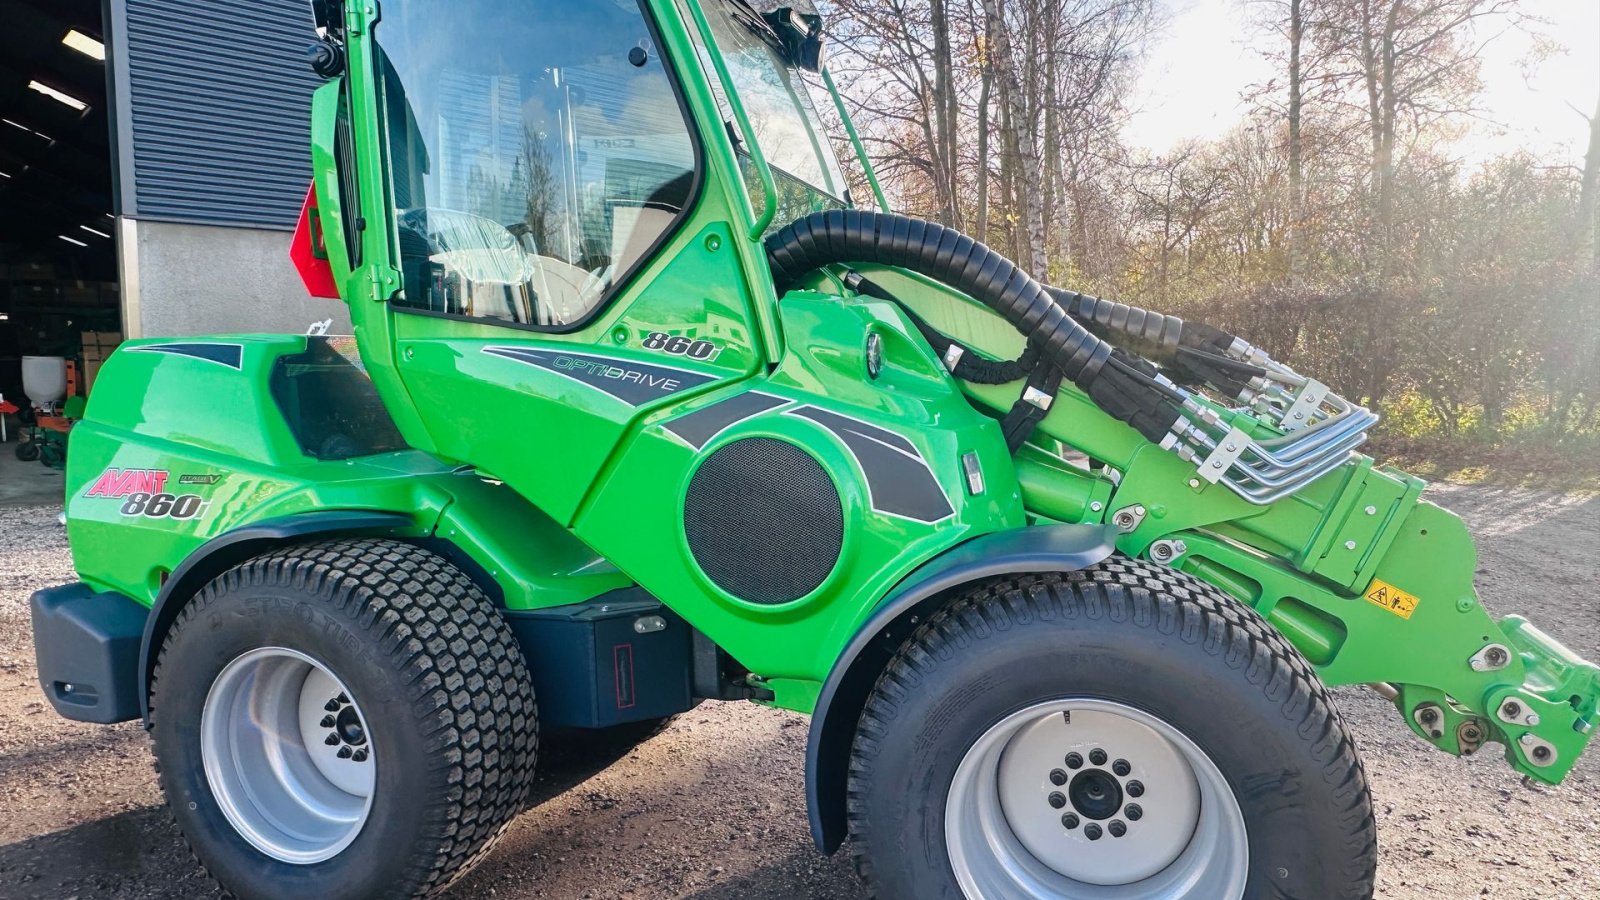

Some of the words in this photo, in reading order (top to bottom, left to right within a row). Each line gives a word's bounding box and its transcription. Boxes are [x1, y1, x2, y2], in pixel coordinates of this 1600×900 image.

[642, 332, 725, 362] 860i
[552, 356, 681, 391] OPTIDRIVE
[83, 468, 169, 498] AVANT
[120, 492, 211, 520] 860i
